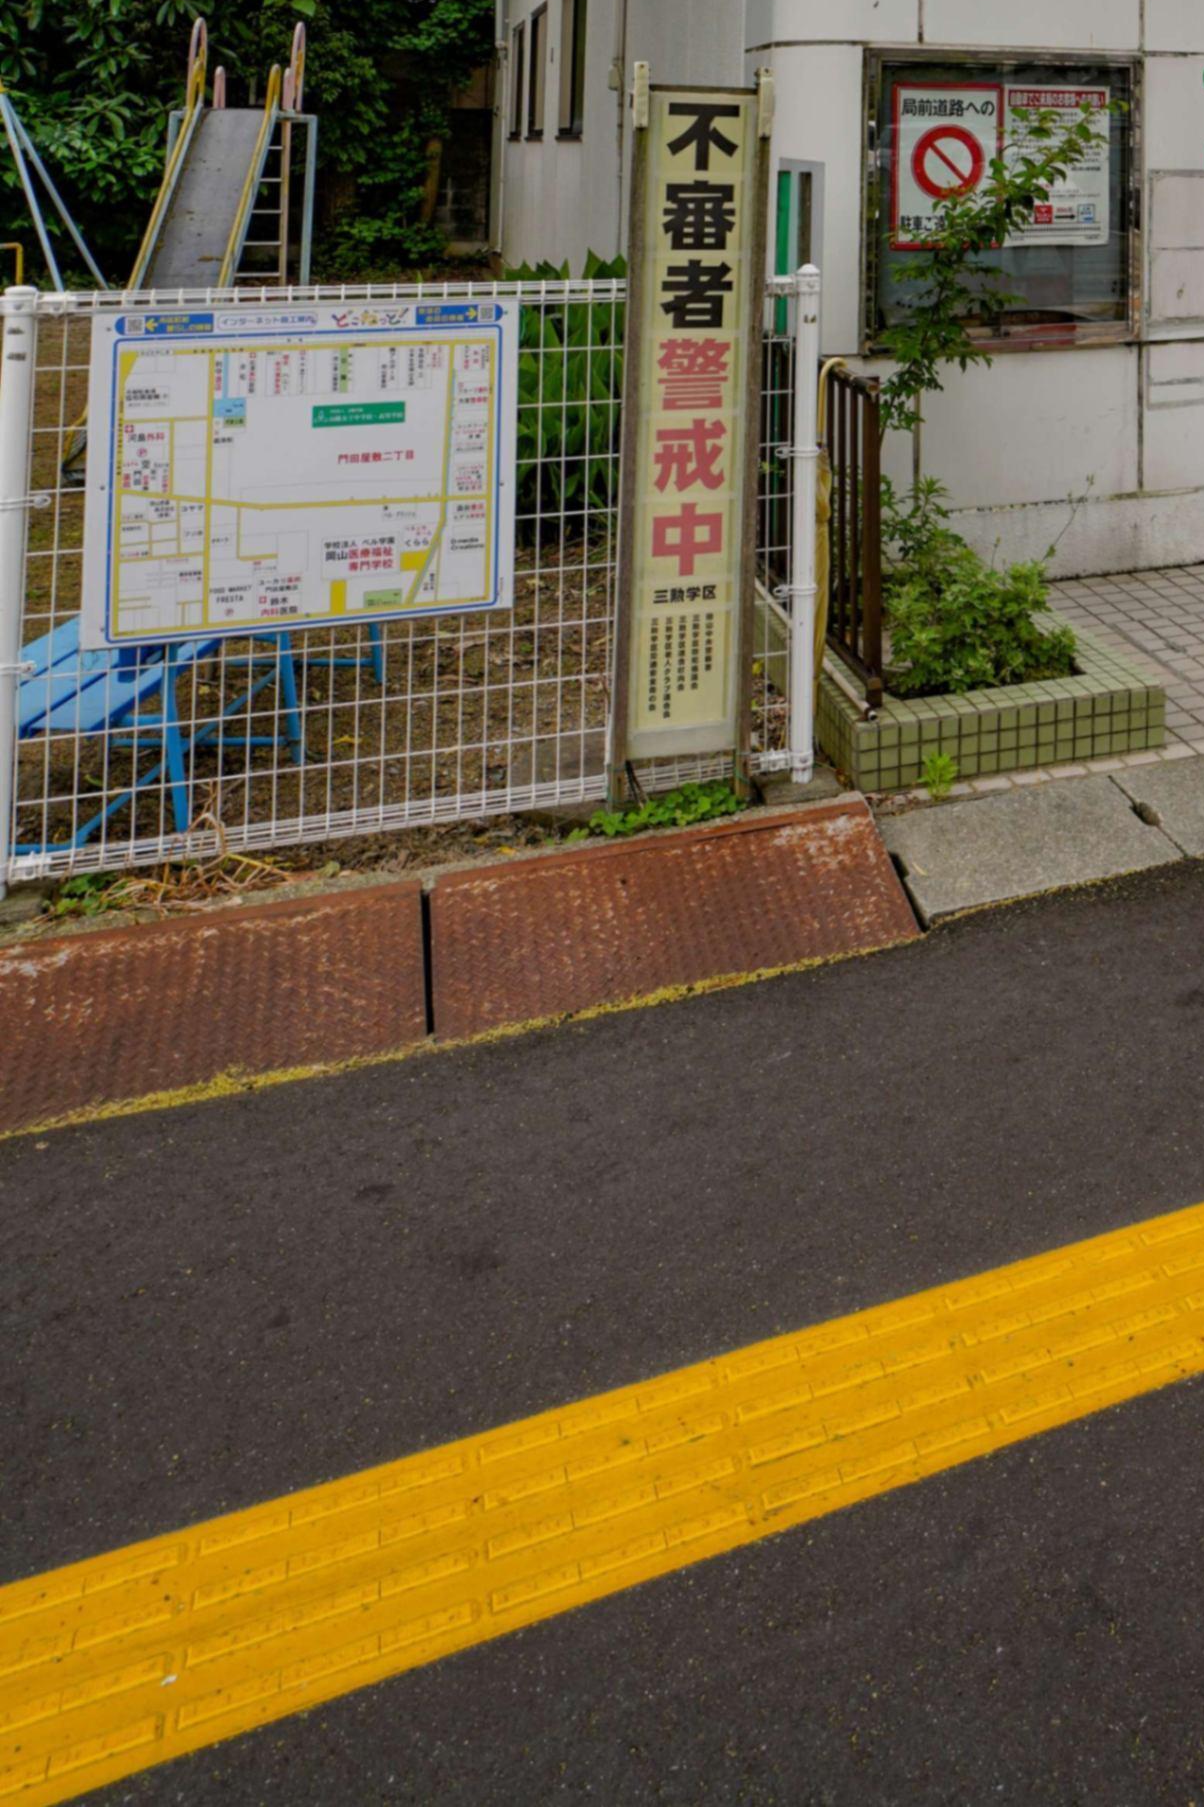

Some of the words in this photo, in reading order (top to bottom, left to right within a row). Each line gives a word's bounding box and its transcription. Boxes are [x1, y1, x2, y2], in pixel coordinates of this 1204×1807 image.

[901, 97, 995, 117] 局前道路への
[652, 101, 740, 577] 不審者警戒中
[338, 449, 415, 465] 門田屋敷二丁目
[325, 546, 393, 562] 岡山医療福祉
[348, 559, 394, 572] 専門学校
[653, 584, 717, 604] 三勲学区
